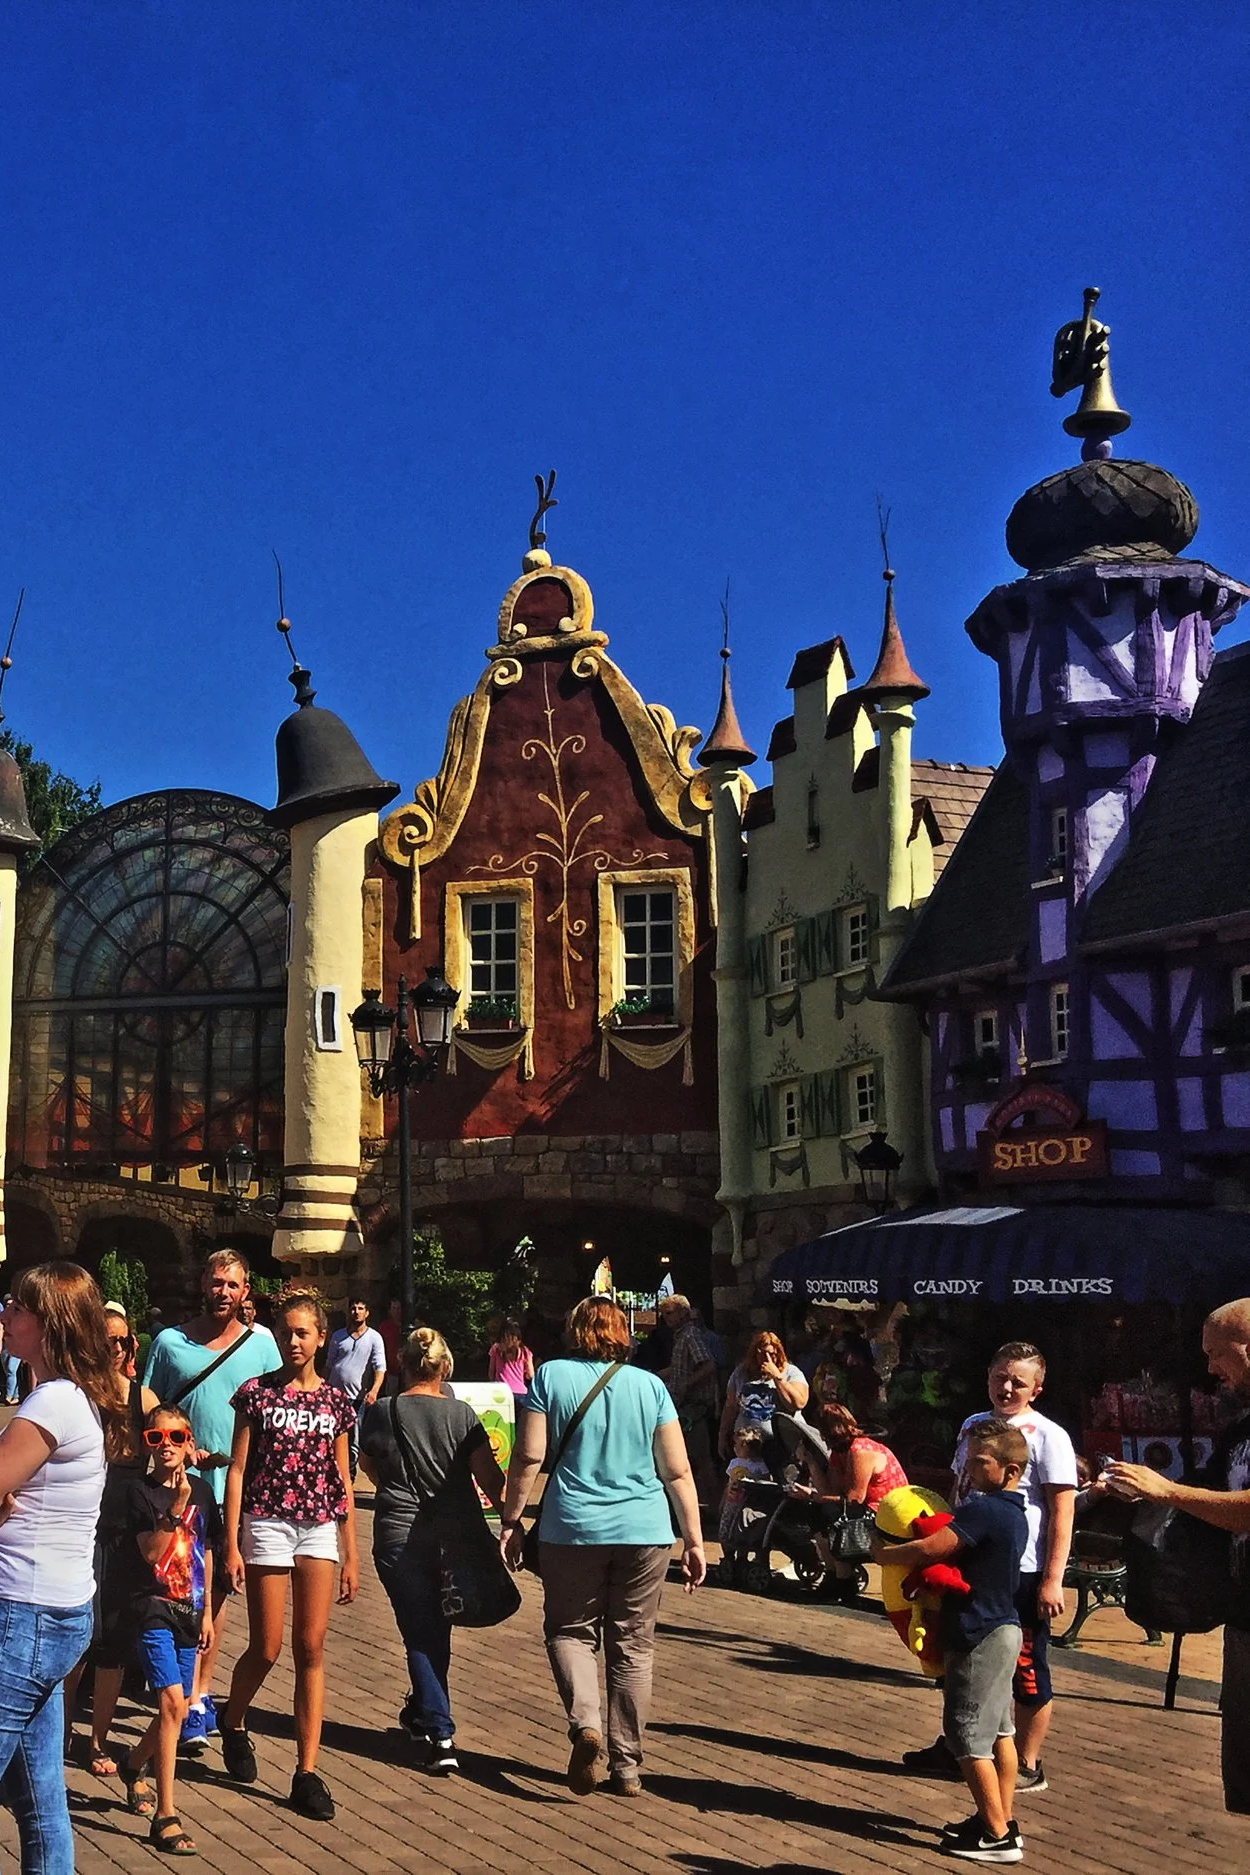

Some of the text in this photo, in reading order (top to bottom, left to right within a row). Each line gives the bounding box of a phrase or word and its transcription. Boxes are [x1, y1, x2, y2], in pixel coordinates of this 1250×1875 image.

[993, 1137, 1092, 1170] SHOP
[772, 1278, 1114, 1295] SHOP SOUVENIRS CANDY DRINKS
[262, 1406, 337, 1440] FOREVER
